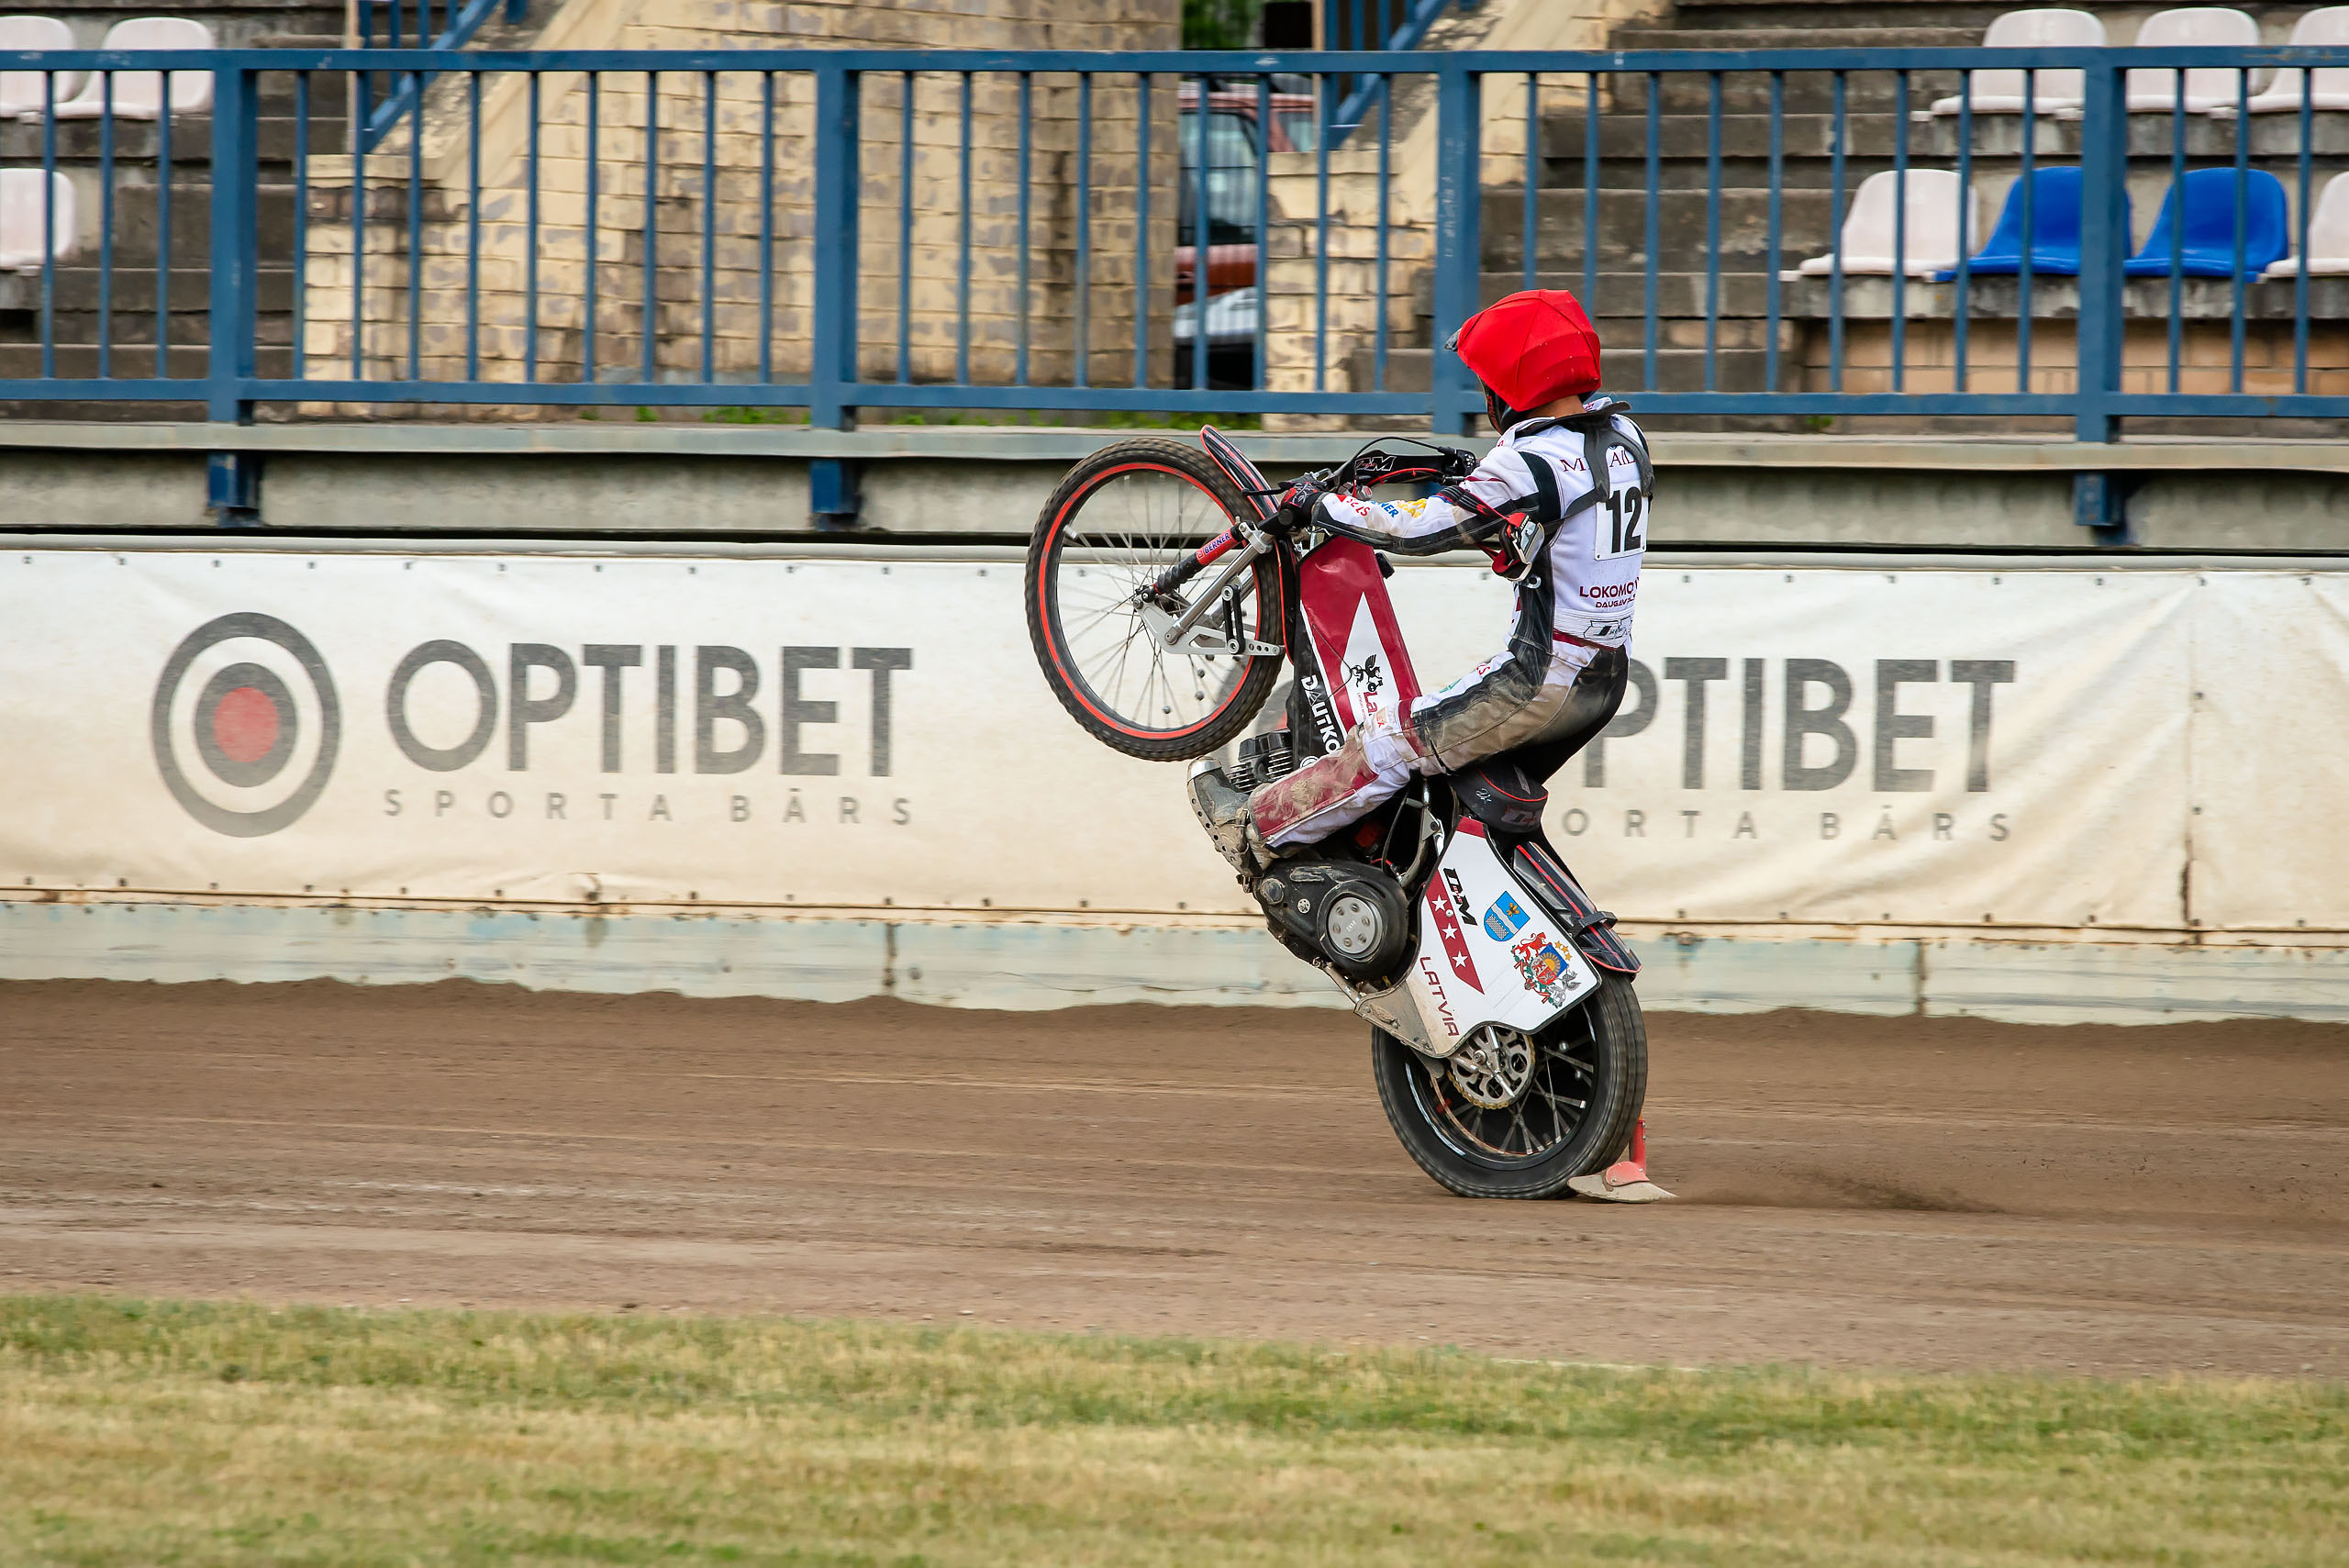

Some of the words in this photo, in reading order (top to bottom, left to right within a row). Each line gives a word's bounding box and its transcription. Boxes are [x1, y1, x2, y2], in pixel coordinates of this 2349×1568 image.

[1204, 532, 1231, 554] BERNER
[1606, 486, 1642, 554] 12
[386, 639, 913, 778] OPTIBET
[1301, 674, 1341, 753] DAUTKO
[1364, 692, 1378, 716] La
[1583, 657, 2017, 793] PTIBET
[385, 788, 673, 822] SPORTA
[729, 788, 911, 826] BĀRS
[1562, 807, 1758, 840] ORTA
[1820, 804, 2010, 842] BĀRS
[1419, 956, 1460, 1037] LATVIA
